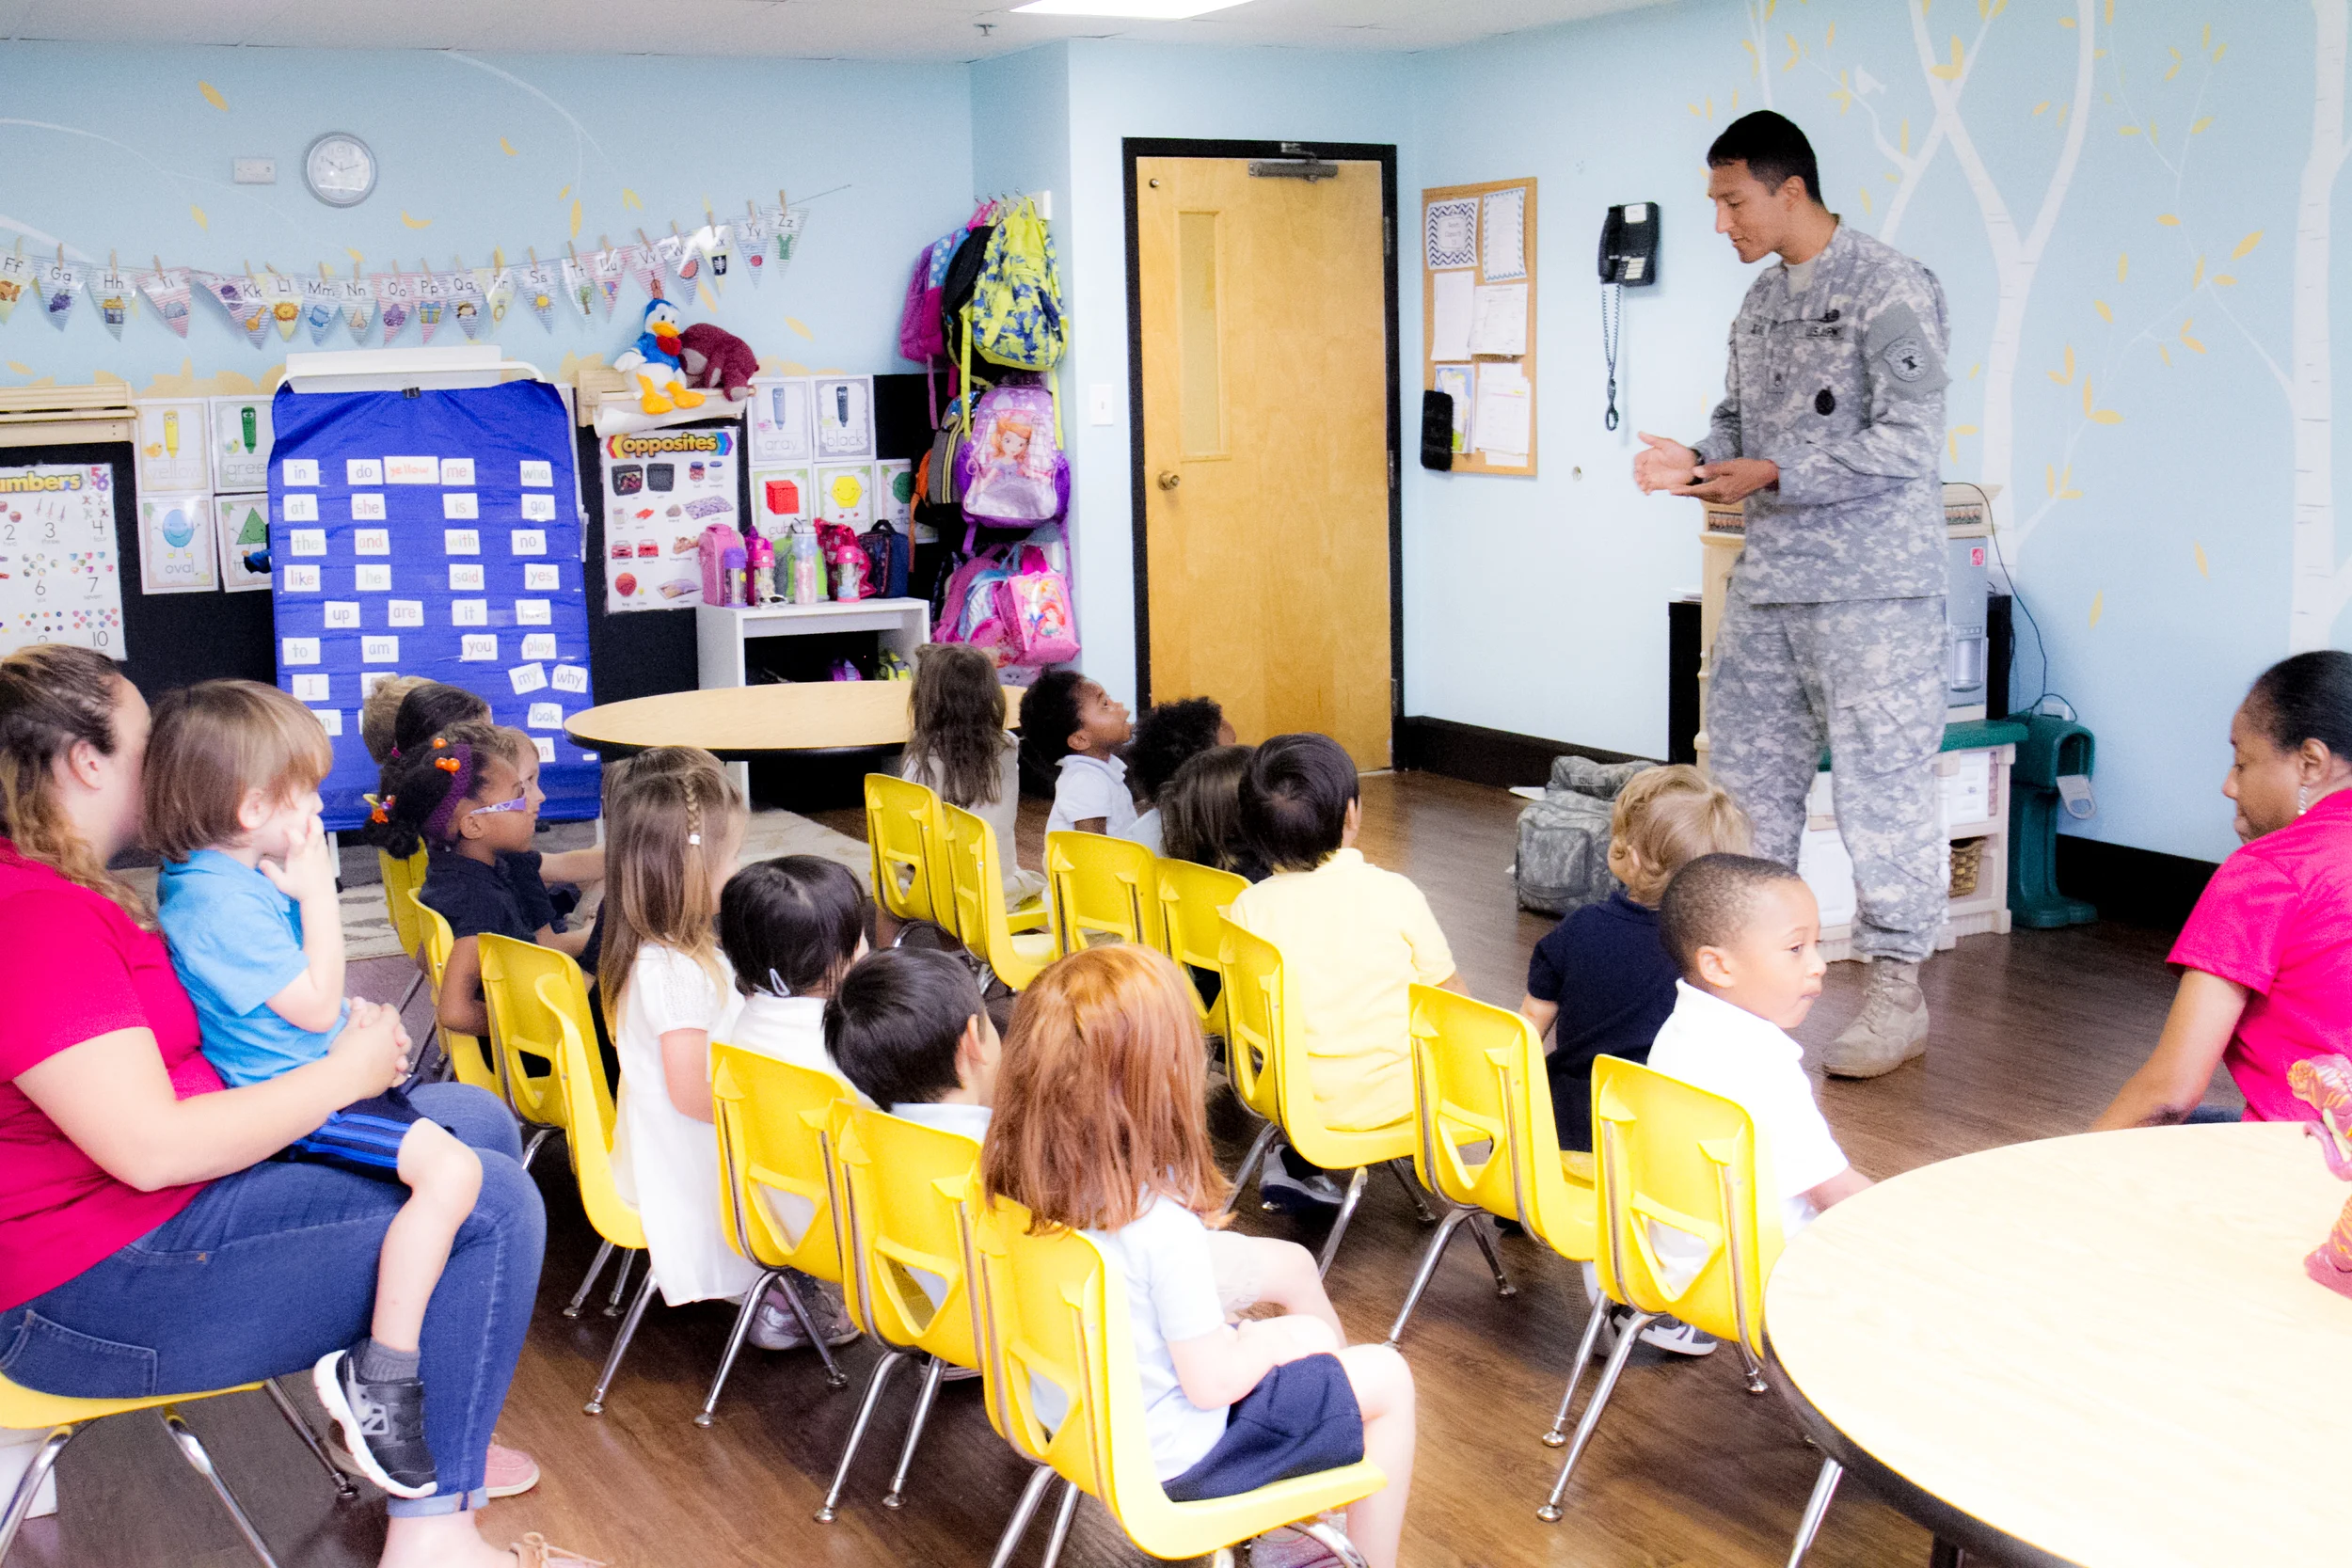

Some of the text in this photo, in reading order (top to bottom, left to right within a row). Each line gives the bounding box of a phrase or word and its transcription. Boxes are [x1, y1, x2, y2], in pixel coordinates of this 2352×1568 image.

[778, 214, 793, 228] Zz
[746, 223, 761, 239] Yy
[639, 250, 657, 264] Vv
[4, 257, 24, 274] Ff
[570, 265, 585, 277] Tt
[51, 266, 72, 285] Gg
[103, 274, 124, 290] Hh
[530, 271, 548, 283] Ss
[243, 283, 262, 298] Kk
[277, 279, 292, 293] Ll
[308, 283, 334, 296] Mm
[347, 283, 366, 296] Nn
[389, 282, 406, 297] Oo
[421, 280, 439, 296] Pp
[453, 278, 476, 293] Qq
[622, 432, 718, 458] opposites
[826, 428, 863, 447] black
[764, 439, 798, 455] gray
[225, 463, 266, 483] gree
[294, 465, 307, 480] in
[356, 464, 373, 479] do
[389, 463, 430, 478] yellow
[446, 466, 468, 478] me
[522, 464, 548, 481] who
[96, 472, 110, 492] 6
[291, 500, 306, 515] at
[356, 499, 380, 515] she
[454, 499, 467, 515] is
[530, 500, 547, 516] go
[4, 524, 16, 541] 2
[44, 521, 56, 539] 3
[92, 519, 104, 535] 4
[768, 519, 792, 536] cub
[294, 533, 320, 550] the
[358, 532, 383, 549] and
[448, 532, 476, 547] with
[519, 535, 537, 548] no
[165, 556, 195, 574] oval
[291, 569, 314, 586] like
[365, 568, 383, 585] he
[453, 569, 480, 583] said
[530, 570, 554, 586] yes
[35, 579, 46, 596] 6
[87, 577, 99, 594] 7
[332, 608, 350, 625] up
[392, 607, 417, 619] are
[464, 606, 475, 621] it
[92, 630, 109, 647] 10
[292, 643, 309, 658] to
[368, 642, 390, 657] am
[467, 641, 492, 657] you
[527, 638, 552, 657] play
[516, 668, 539, 687] my
[556, 669, 583, 689] why
[532, 706, 559, 723] look
